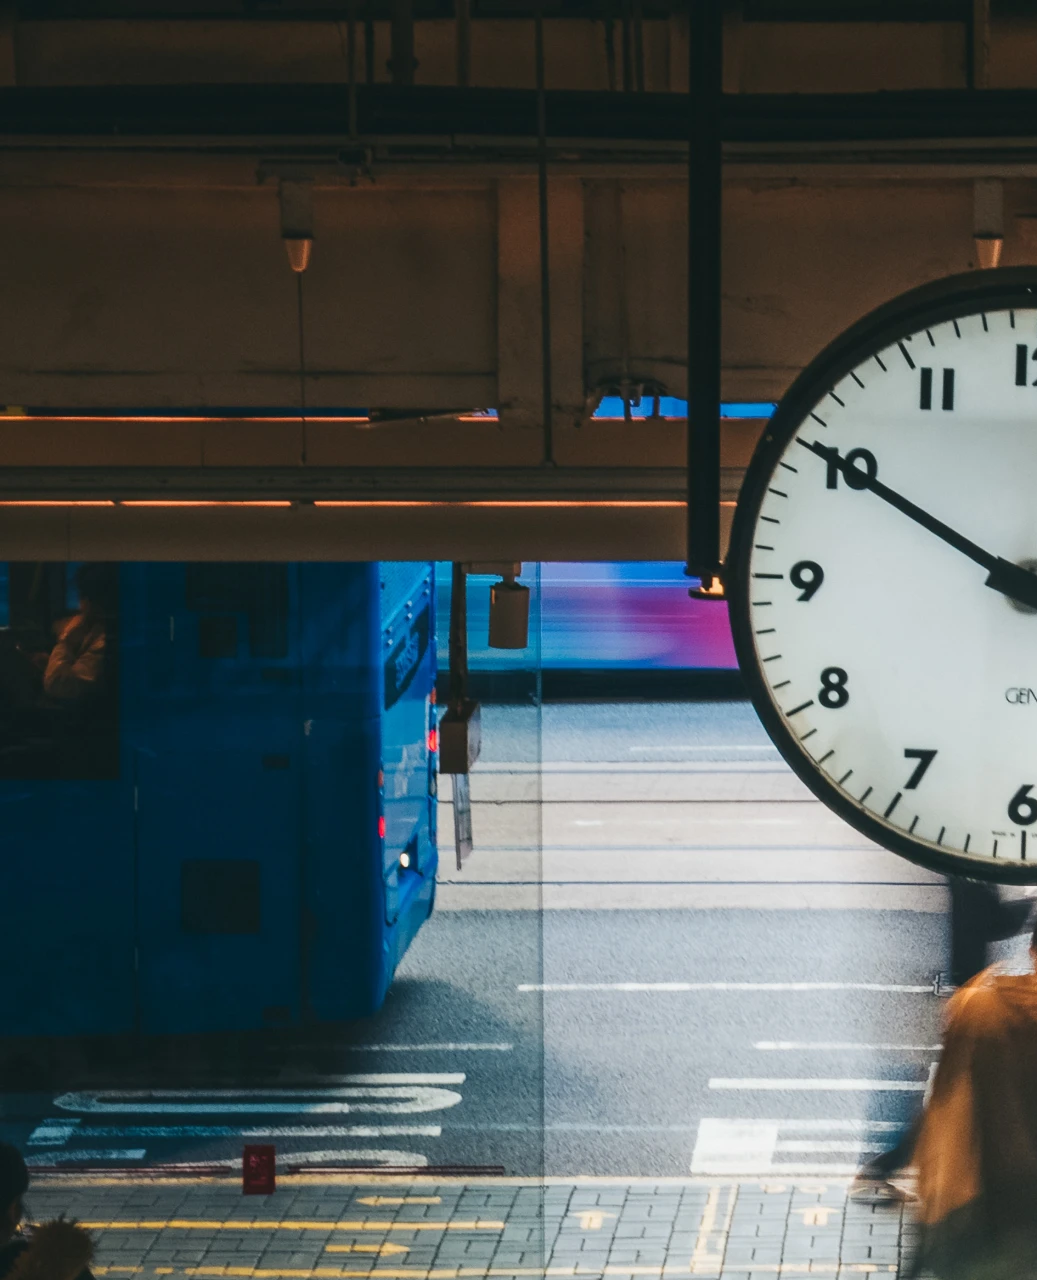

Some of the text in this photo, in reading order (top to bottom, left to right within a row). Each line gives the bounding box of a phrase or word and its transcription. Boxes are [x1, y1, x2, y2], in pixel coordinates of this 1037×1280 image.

[919, 367, 955, 412] 11
[824, 447, 878, 490] 10
[790, 560, 824, 602] 9
[818, 667, 849, 709] 8
[903, 748, 938, 790] 7
